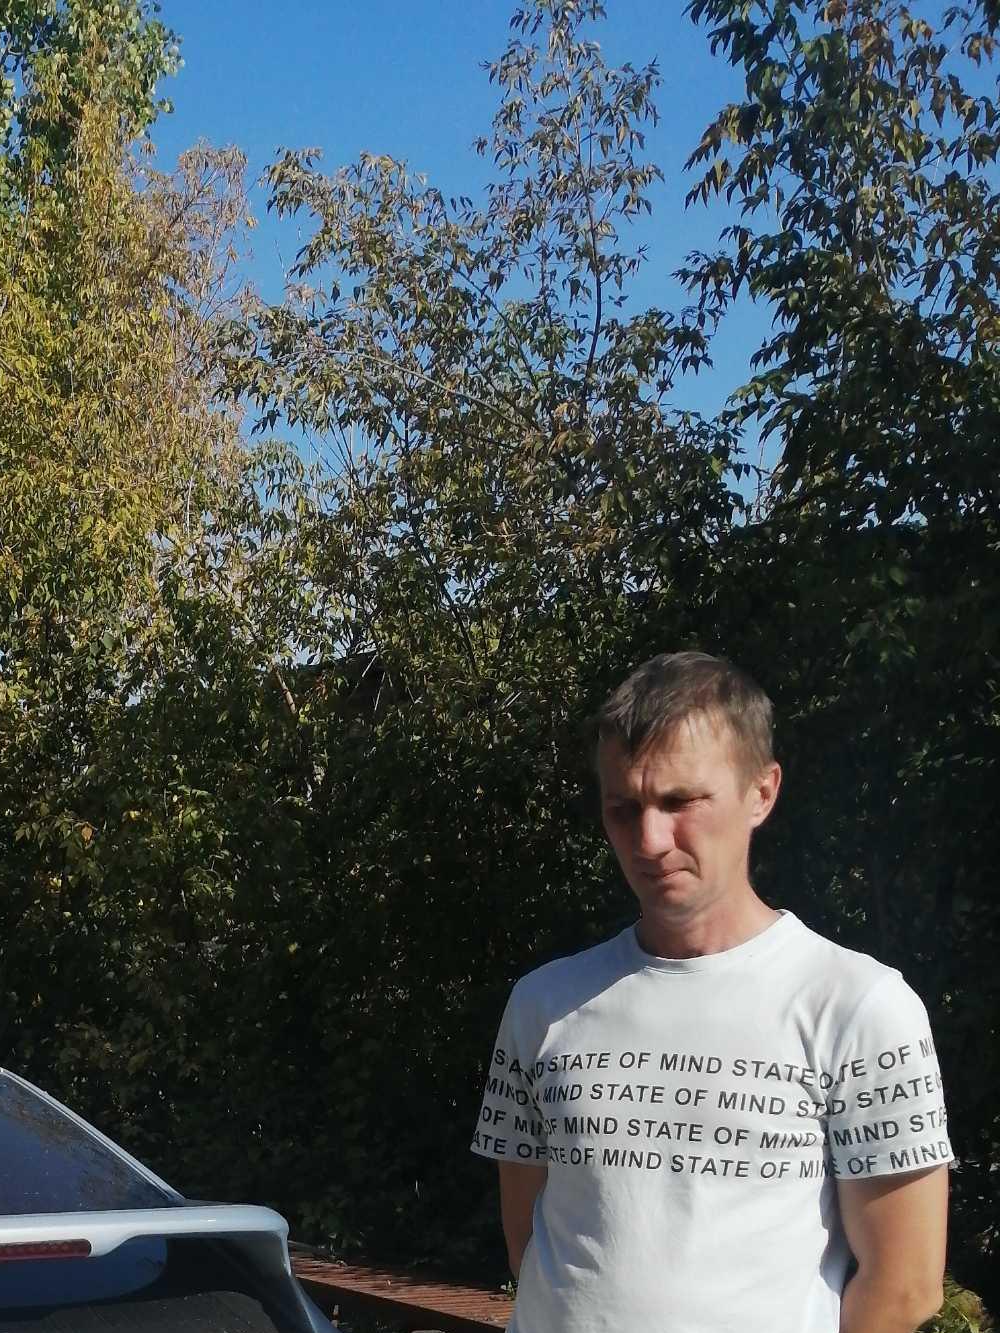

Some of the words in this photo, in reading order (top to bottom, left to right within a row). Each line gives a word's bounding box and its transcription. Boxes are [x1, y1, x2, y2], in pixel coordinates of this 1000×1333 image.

[547, 1052, 611, 1073] STATE
[619, 1051, 651, 1069] OF
[659, 1053, 722, 1074] MIND
[732, 1059, 815, 1087] STATE
[877, 1044, 911, 1071] OF
[589, 1083, 665, 1104] STATE
[674, 1087, 709, 1107] OF
[717, 1091, 786, 1115] MIND
[856, 1073, 933, 1109] STATE
[482, 1106, 507, 1126] OF
[564, 1117, 618, 1136] MIND
[626, 1118, 704, 1143] STATE
[713, 1126, 750, 1147] OF
[759, 1131, 818, 1149] MIND
[833, 1120, 900, 1147] MIND
[517, 1143, 549, 1160] OF
[570, 1146, 595, 1165] OF
[603, 1149, 662, 1170] MIND
[670, 1154, 751, 1178] STATE
[760, 1161, 791, 1179] OF
[847, 1154, 879, 1175] OF
[889, 1140, 950, 1170] MIND
